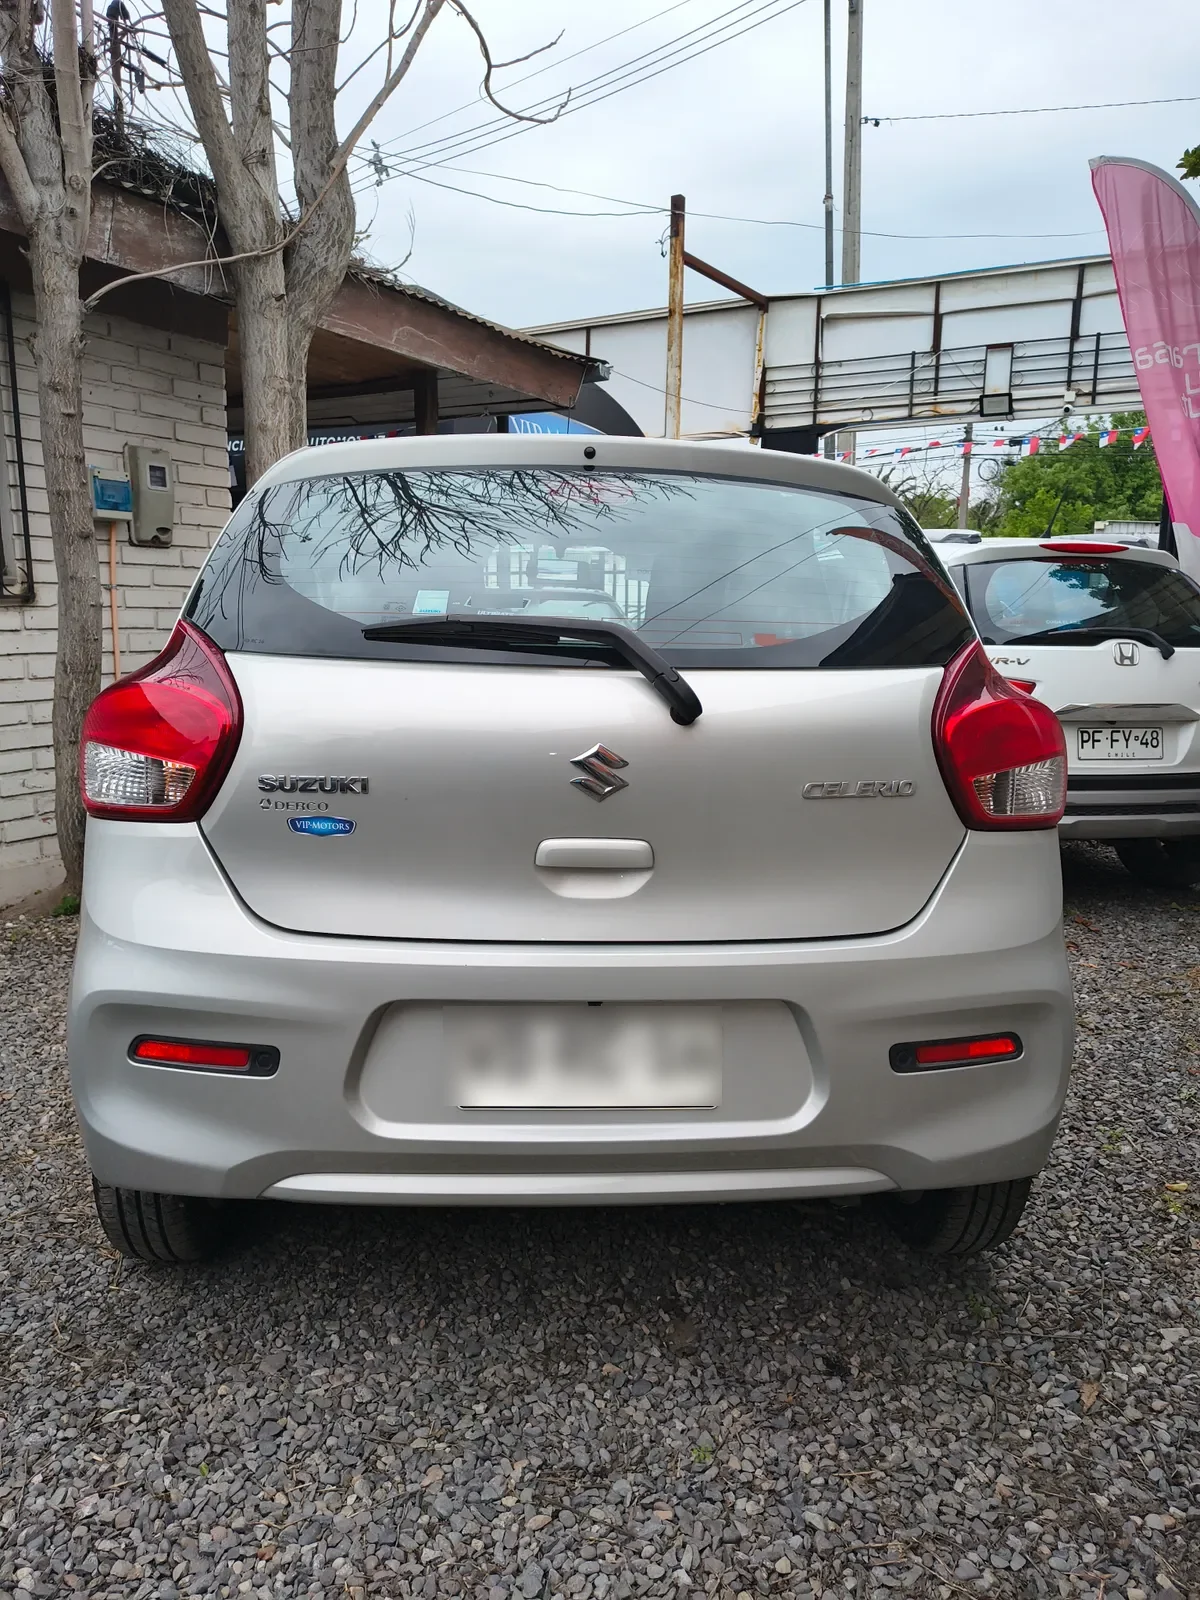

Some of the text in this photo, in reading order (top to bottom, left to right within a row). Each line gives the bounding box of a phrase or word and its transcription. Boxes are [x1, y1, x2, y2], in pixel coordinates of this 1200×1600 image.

[257, 774, 370, 795] SUZUKI
[801, 779, 918, 800] CELERIO
[274, 800, 330, 813] DERCO
[295, 820, 351, 831] VIP-MOTORS
